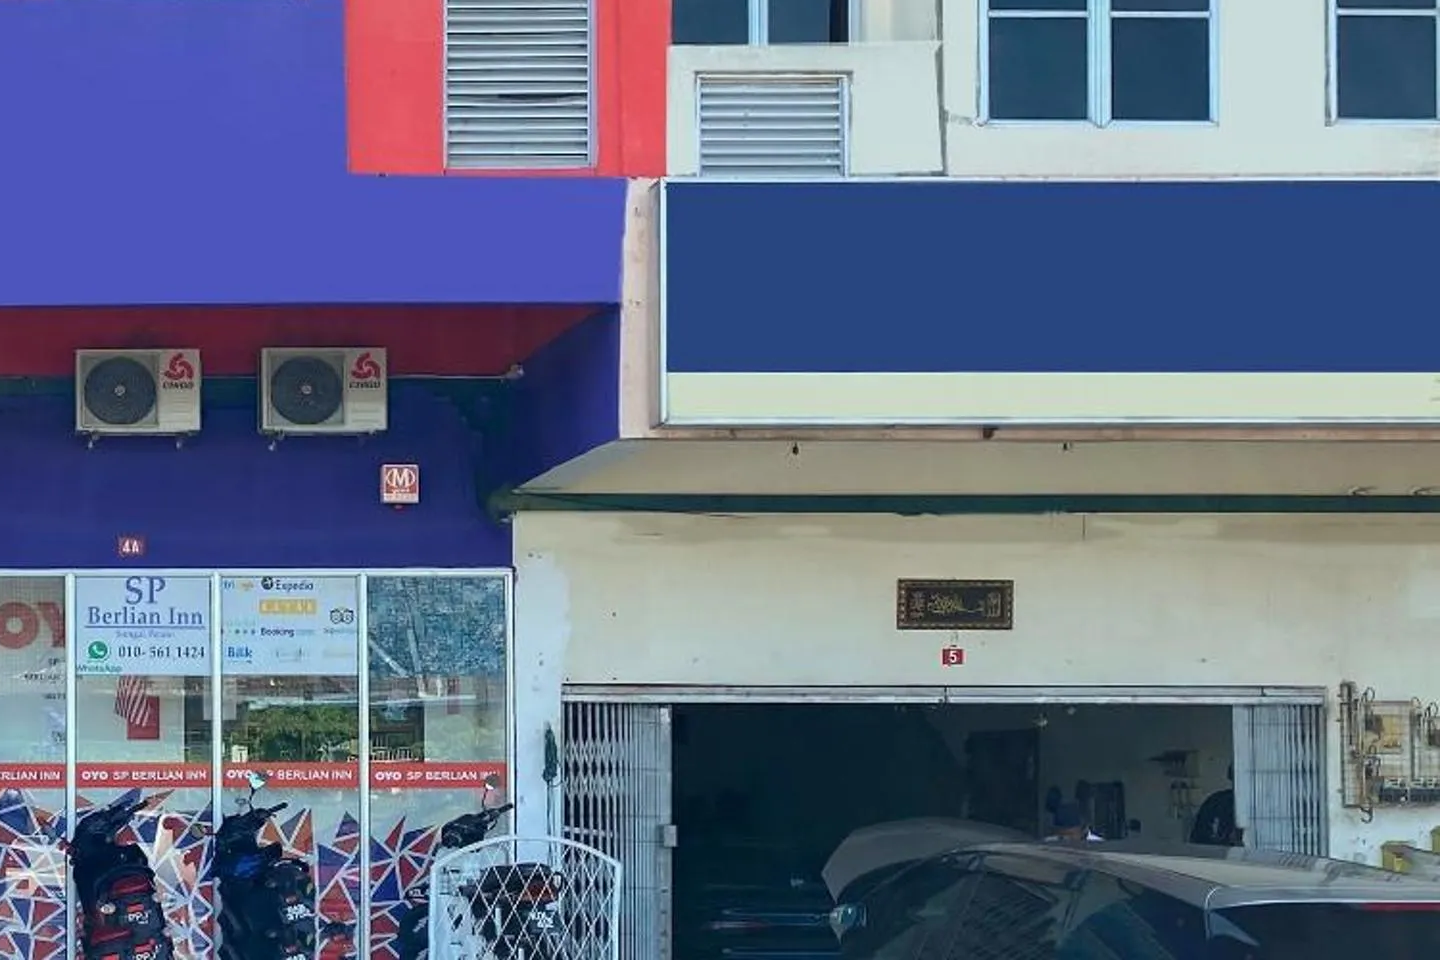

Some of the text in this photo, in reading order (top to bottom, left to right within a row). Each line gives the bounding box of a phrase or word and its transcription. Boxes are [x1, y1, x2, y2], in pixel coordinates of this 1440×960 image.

[125, 575, 166, 605] SP
[88, 606, 204, 625] Berlian Inn
[176, 646, 205, 658] 1424
[948, 650, 957, 663] 5
[40, 770, 61, 781] INN
[81, 771, 108, 781] OYO
[132, 770, 183, 781] BERLIAN
[186, 770, 207, 780] INN
[277, 769, 329, 780] BERLIAN
[331, 769, 353, 780] INN
[375, 771, 402, 781] OYO
[406, 771, 423, 780] SP
[425, 770, 478, 780] BERLIAN
